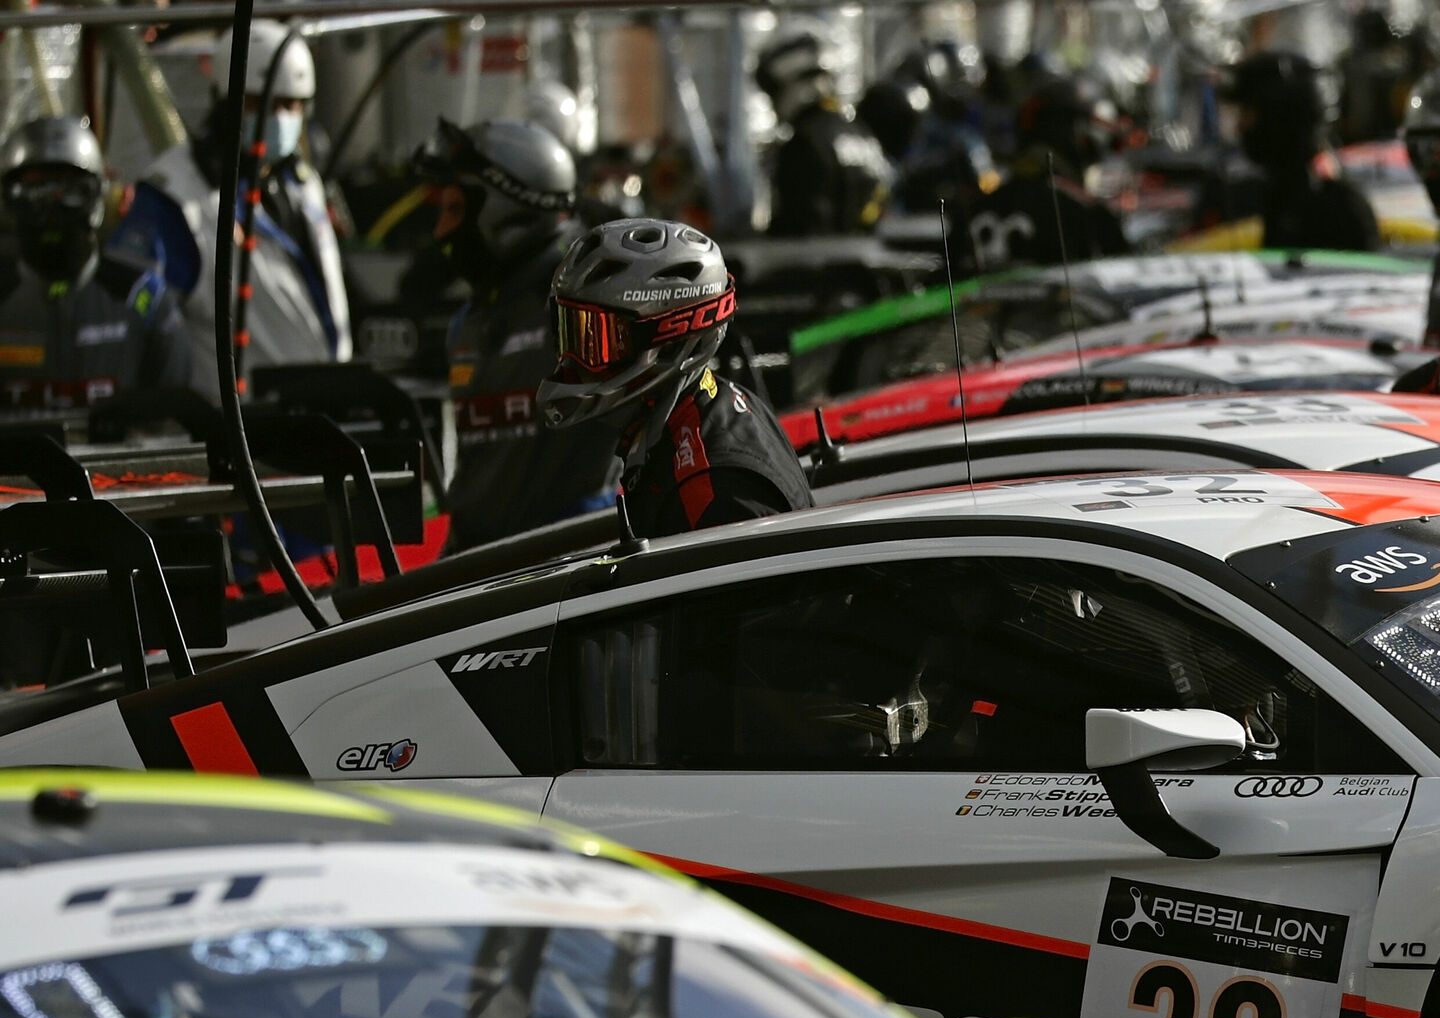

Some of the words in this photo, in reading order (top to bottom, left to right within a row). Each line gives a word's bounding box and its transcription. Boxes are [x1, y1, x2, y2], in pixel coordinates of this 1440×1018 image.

[623, 288, 671, 301] COUSIN
[674, 285, 700, 300] COIN
[652, 292, 736, 343] SCO
[1078, 475, 1268, 498] 32
[1196, 496, 1266, 505] PRO
[1335, 546, 1428, 585] aws
[450, 646, 549, 674] WRT
[337, 743, 392, 771] elf
[1333, 787, 1376, 796] Audi
[1378, 787, 1409, 797] Club
[1339, 776, 1390, 787] Belgian
